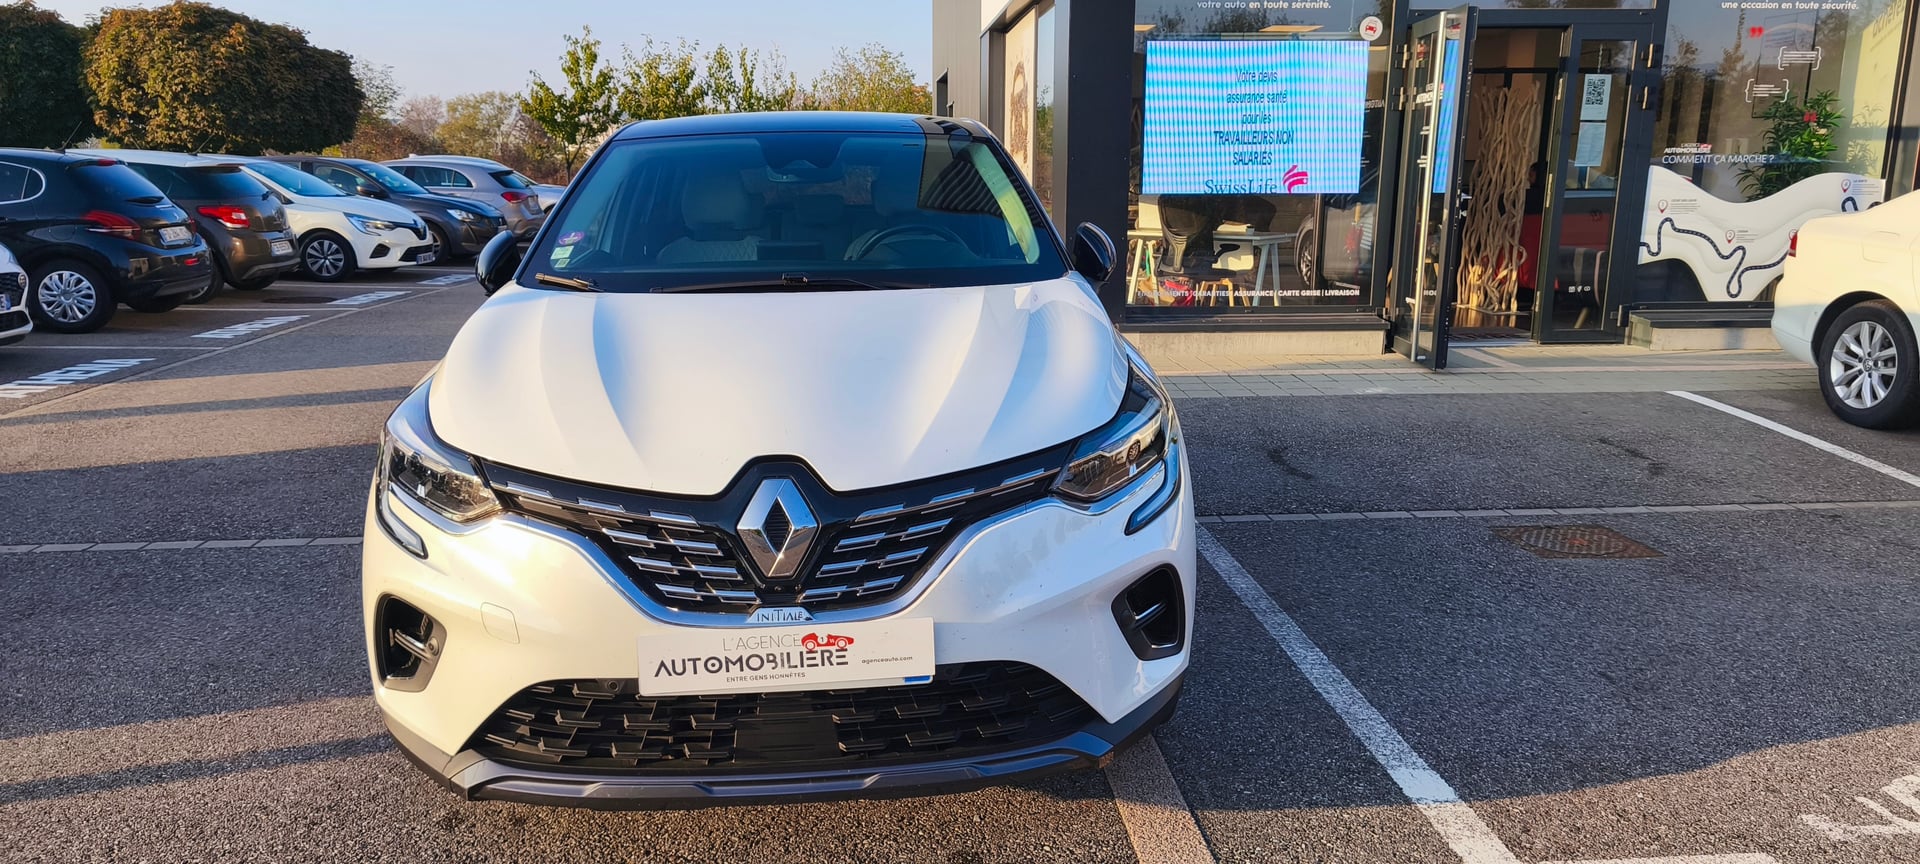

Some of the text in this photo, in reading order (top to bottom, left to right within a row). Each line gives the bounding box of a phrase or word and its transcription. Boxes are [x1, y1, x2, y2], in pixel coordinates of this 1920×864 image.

[1197, 0, 1221, 9] votre
[1224, 0, 1246, 9] auto
[1249, 1, 1261, 9] en
[1263, 0, 1289, 9] toute
[1740, 0, 1779, 9] occasion
[1795, 0, 1820, 10] toute
[1821, 0, 1859, 10] sécurité.
[1236, 68, 1278, 83] Votre devis
[1226, 89, 1288, 104] assurance santé
[1213, 129, 1295, 145] TRAVAILLEURS NON
[1662, 154, 1713, 164] COMMENT
[1713, 153, 1727, 165] ÇA
[1727, 154, 1767, 164] MARCHE
[1203, 178, 1278, 194] SwissLife
[1301, 289, 1321, 297] GRISE
[757, 608, 803, 622] INITIALE
[722, 633, 802, 652] L'AGENCE
[861, 655, 914, 665] agenceauto.com
[726, 675, 749, 683] ENTRE
